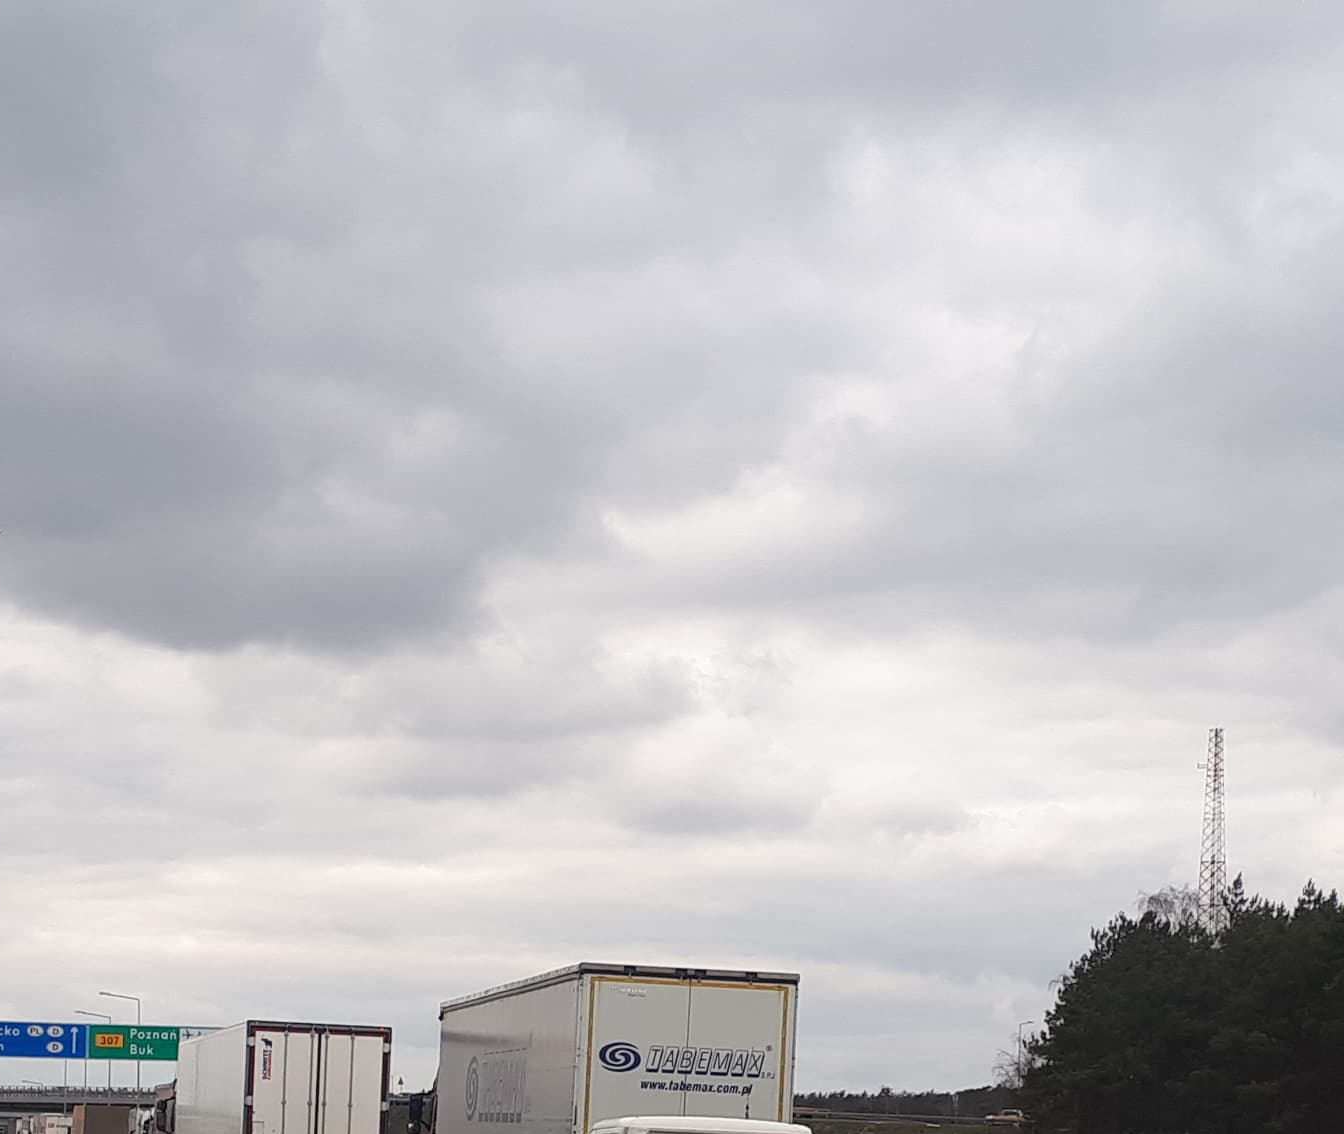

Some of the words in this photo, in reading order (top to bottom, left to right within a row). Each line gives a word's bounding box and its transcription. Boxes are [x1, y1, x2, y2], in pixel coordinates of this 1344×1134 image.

[29, 1026, 41, 1035] PL
[129, 1028, 177, 1040] Poznań
[100, 1035, 120, 1046] 307
[129, 1043, 154, 1055] Buk
[646, 1045, 765, 1077] TABEMAX
[640, 1081, 752, 1096] www.tabemax.com.pl
